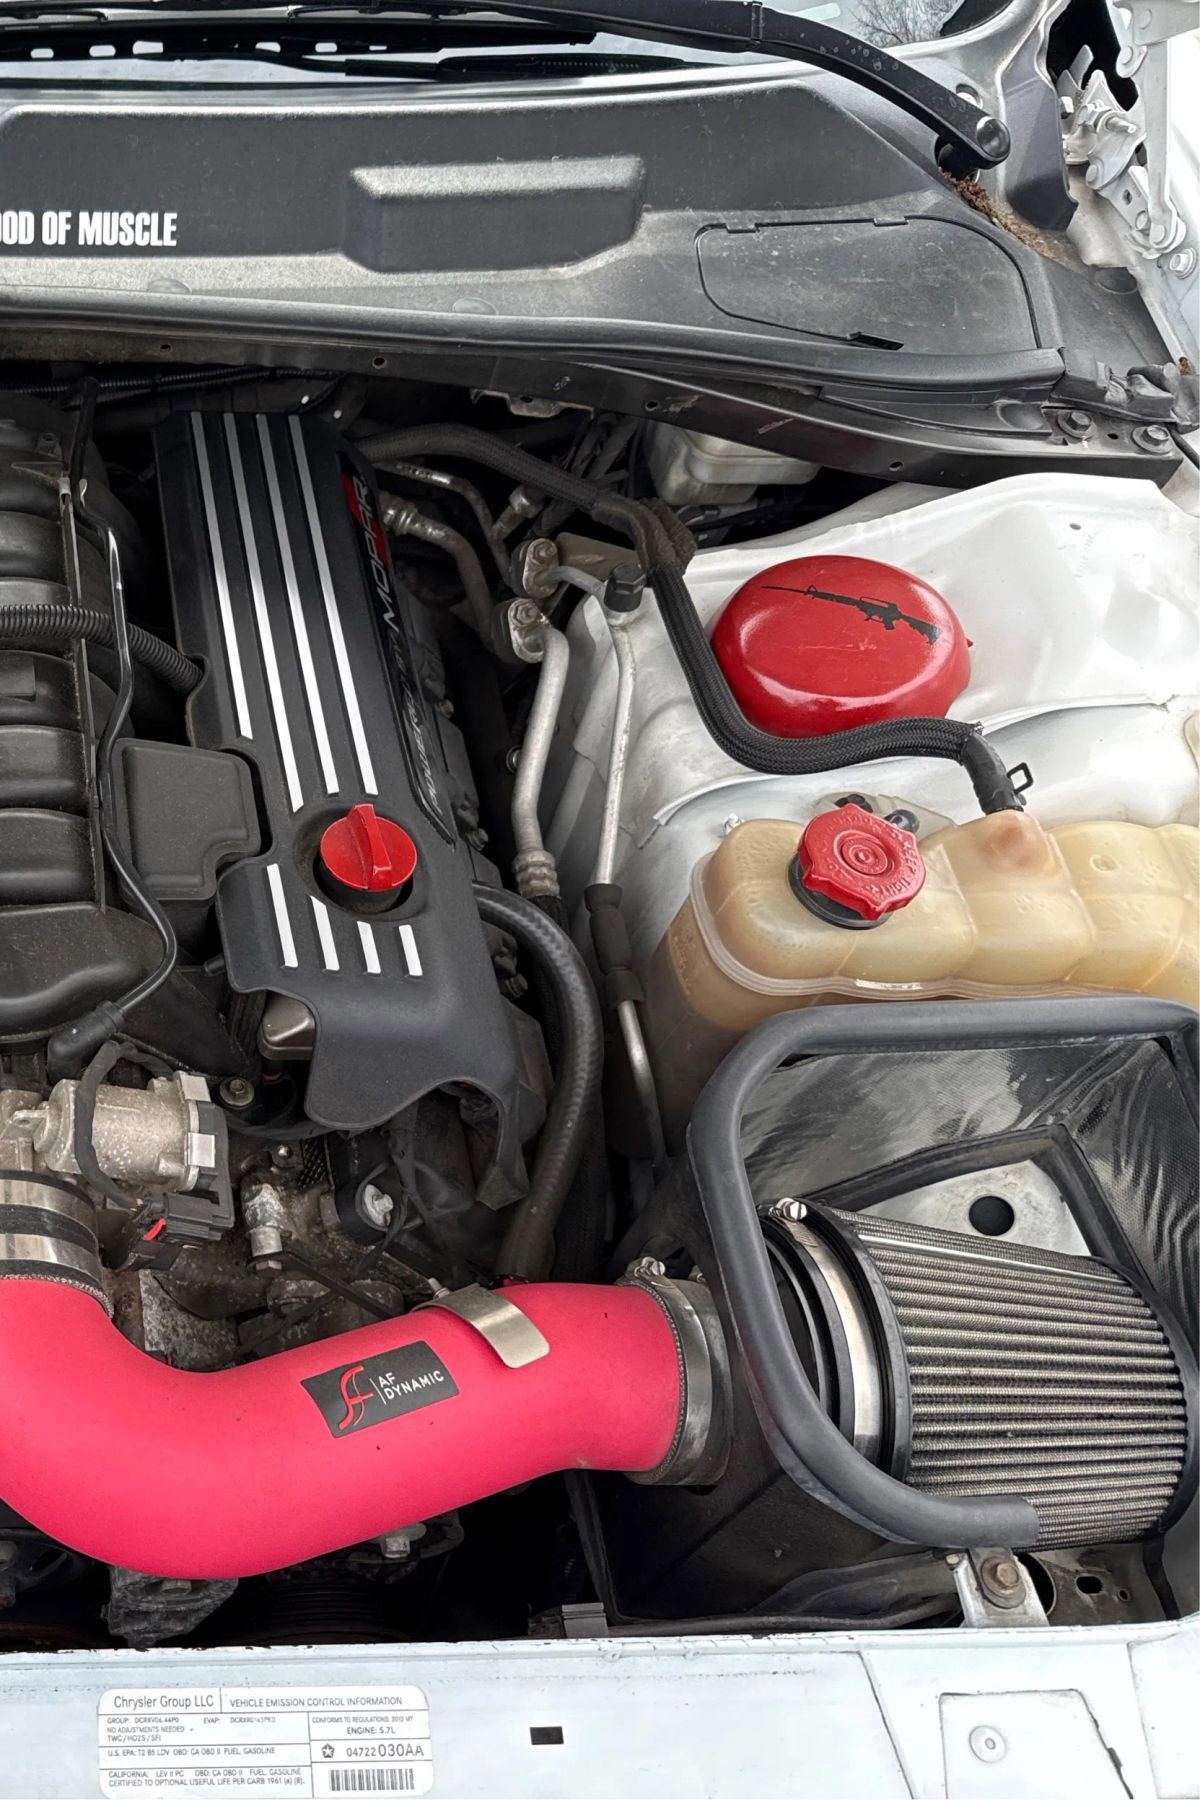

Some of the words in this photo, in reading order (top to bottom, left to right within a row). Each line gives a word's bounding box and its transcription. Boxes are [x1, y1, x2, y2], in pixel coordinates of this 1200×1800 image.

[42, 210, 71, 246] OF
[78, 211, 178, 247] MUSCLE
[353, 475, 400, 633] MOPAR
[378, 1372, 396, 1388] AF
[384, 1370, 444, 1400] DYNAMIC
[113, 1695, 157, 1710] Chrysler
[159, 1695, 191, 1710] Group
[194, 1694, 214, 1707] LLC
[229, 1699, 264, 1708] VEHICLE
[265, 1698, 305, 1707] EMISSION
[307, 1697, 345, 1707] CONTROL
[347, 1697, 402, 1706] INFORMATION
[312, 1716, 343, 1724] CONFORMS
[161, 1725, 185, 1733] NEEDED
[346, 1726, 378, 1735] ENGINE:
[379, 1726, 396, 1735] 5.7L
[108, 1749, 120, 1757] U.S.
[157, 1748, 170, 1756] LDV
[243, 1747, 276, 1755] GASOLINE
[346, 1747, 376, 1757] 04722
[377, 1743, 425, 1757] 030AA
[155, 1770, 169, 1778] LEV
[212, 1769, 221, 1777] CA
[223, 1769, 237, 1777] OBD
[269, 1768, 302, 1776] GASOLINE
[108, 1779, 142, 1787] CERTIFIED
[190, 1778, 216, 1786] USEFUL
[247, 1777, 265, 1785] CARB
[267, 1777, 282, 1785] 1961
